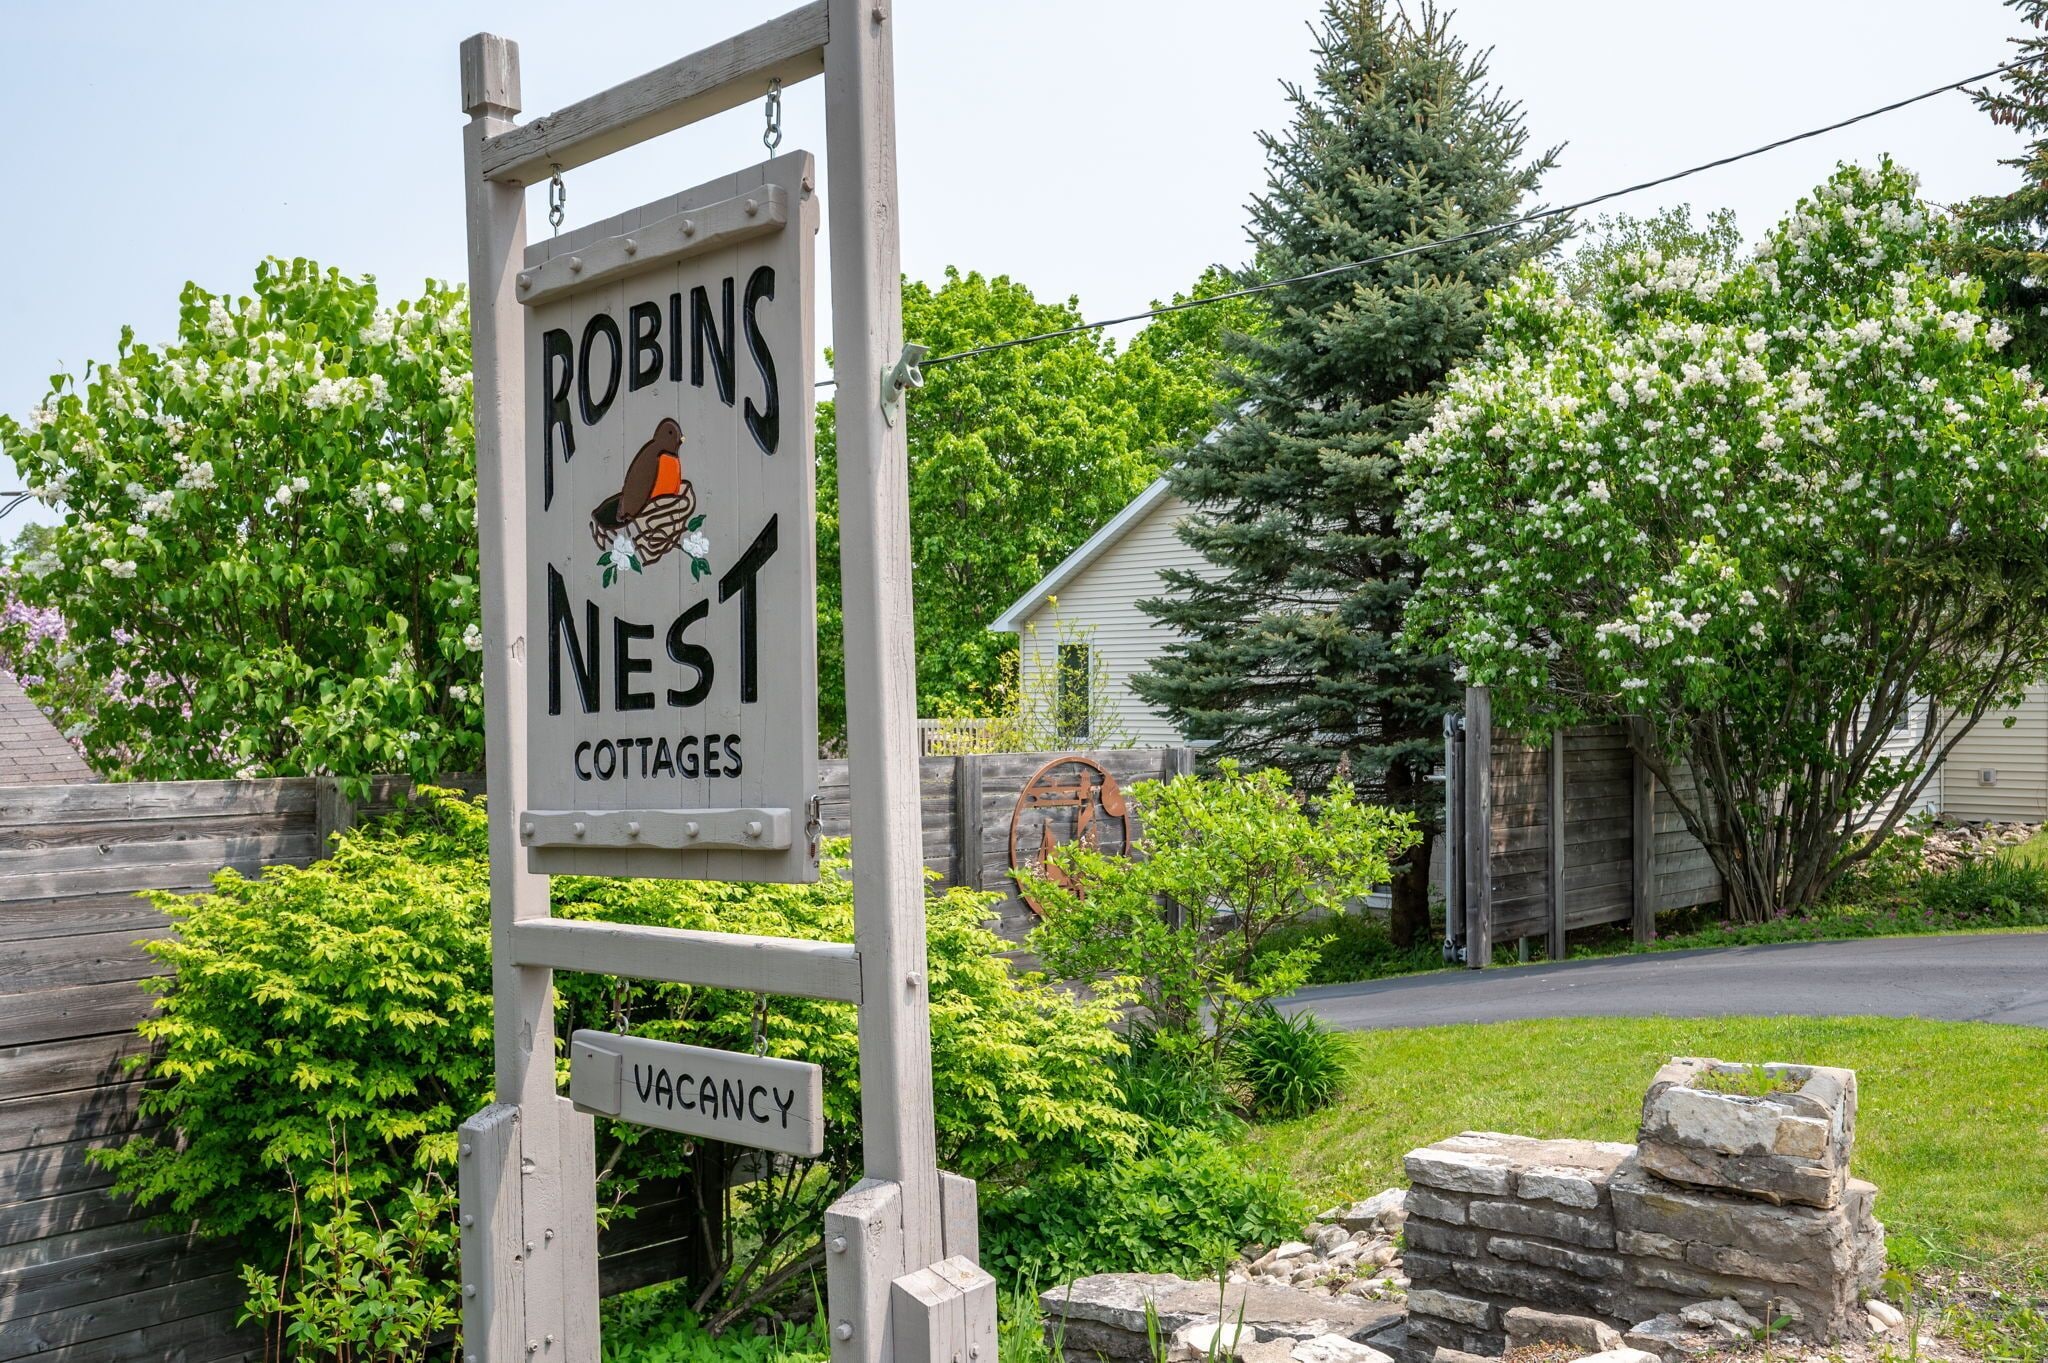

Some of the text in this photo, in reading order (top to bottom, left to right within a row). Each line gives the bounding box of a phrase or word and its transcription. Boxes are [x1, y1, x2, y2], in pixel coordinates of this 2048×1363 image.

[543, 265, 780, 512] ROBINS
[547, 513, 779, 717] NEST
[573, 733, 744, 783] COTTAGES
[634, 1063, 795, 1130] VACANCY
